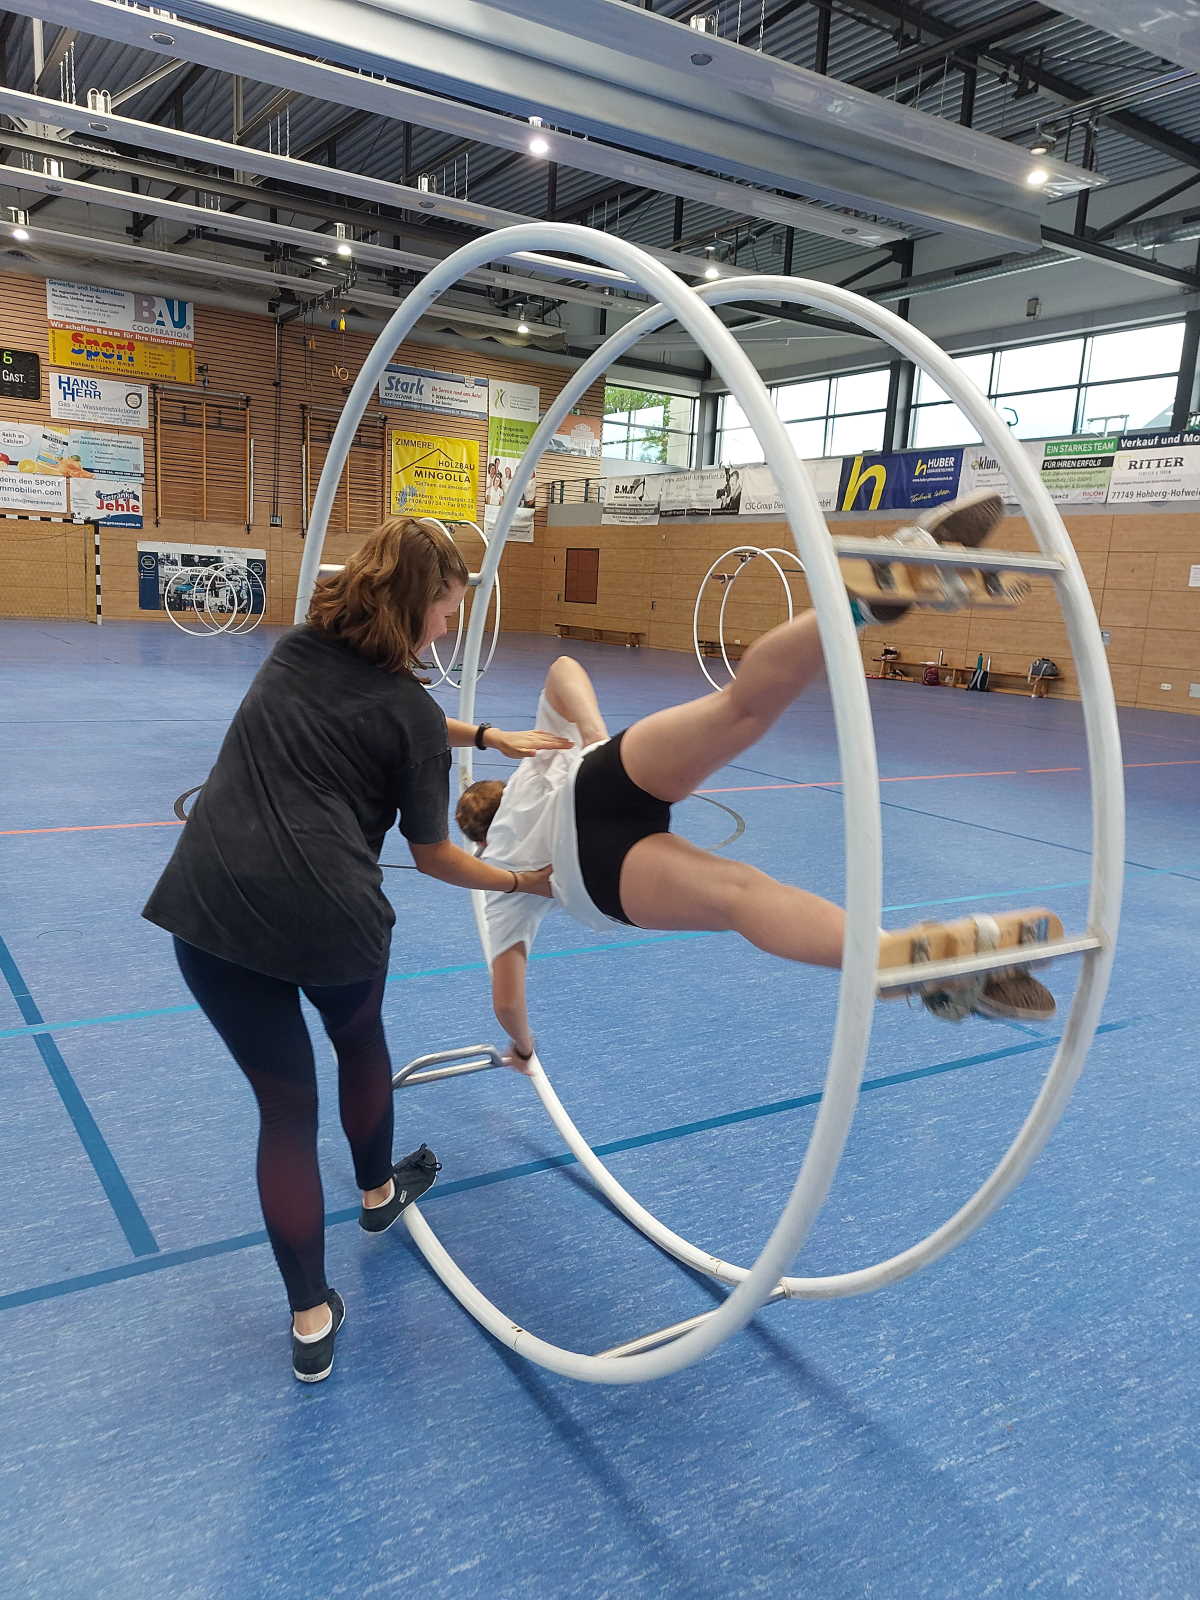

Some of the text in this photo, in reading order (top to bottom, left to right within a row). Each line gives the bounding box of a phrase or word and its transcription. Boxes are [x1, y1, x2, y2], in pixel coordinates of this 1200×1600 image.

[134, 294, 188, 329] BAU
[64, 323, 95, 334] schaffen
[135, 333, 149, 341] Ihre
[150, 336, 193, 349] Innovationen
[132, 324, 189, 339] COOPERATION
[71, 332, 136, 362] Sport
[3, 351, 13, 365] 6
[58, 375, 98, 390] HANS
[385, 375, 425, 396] Stark
[63, 386, 102, 402] HERR
[395, 438, 435, 450] ZIMMEREI
[1046, 441, 1114, 454] EIN STARKES TEAM
[1120, 436, 1159, 448] Verkauf
[1161, 434, 1181, 445] und
[438, 460, 475, 471] HOLZBAU
[928, 456, 955, 469] HUBER
[1043, 458, 1102, 469] FÜR IHREN ERFOLG
[1127, 456, 1184, 470] RITTER
[19, 478, 33, 486] den
[34, 479, 63, 487] SPORT
[414, 470, 471, 484] MINGOLLA
[1111, 491, 1135, 500] 77749
[96, 498, 140, 513] Jehle
